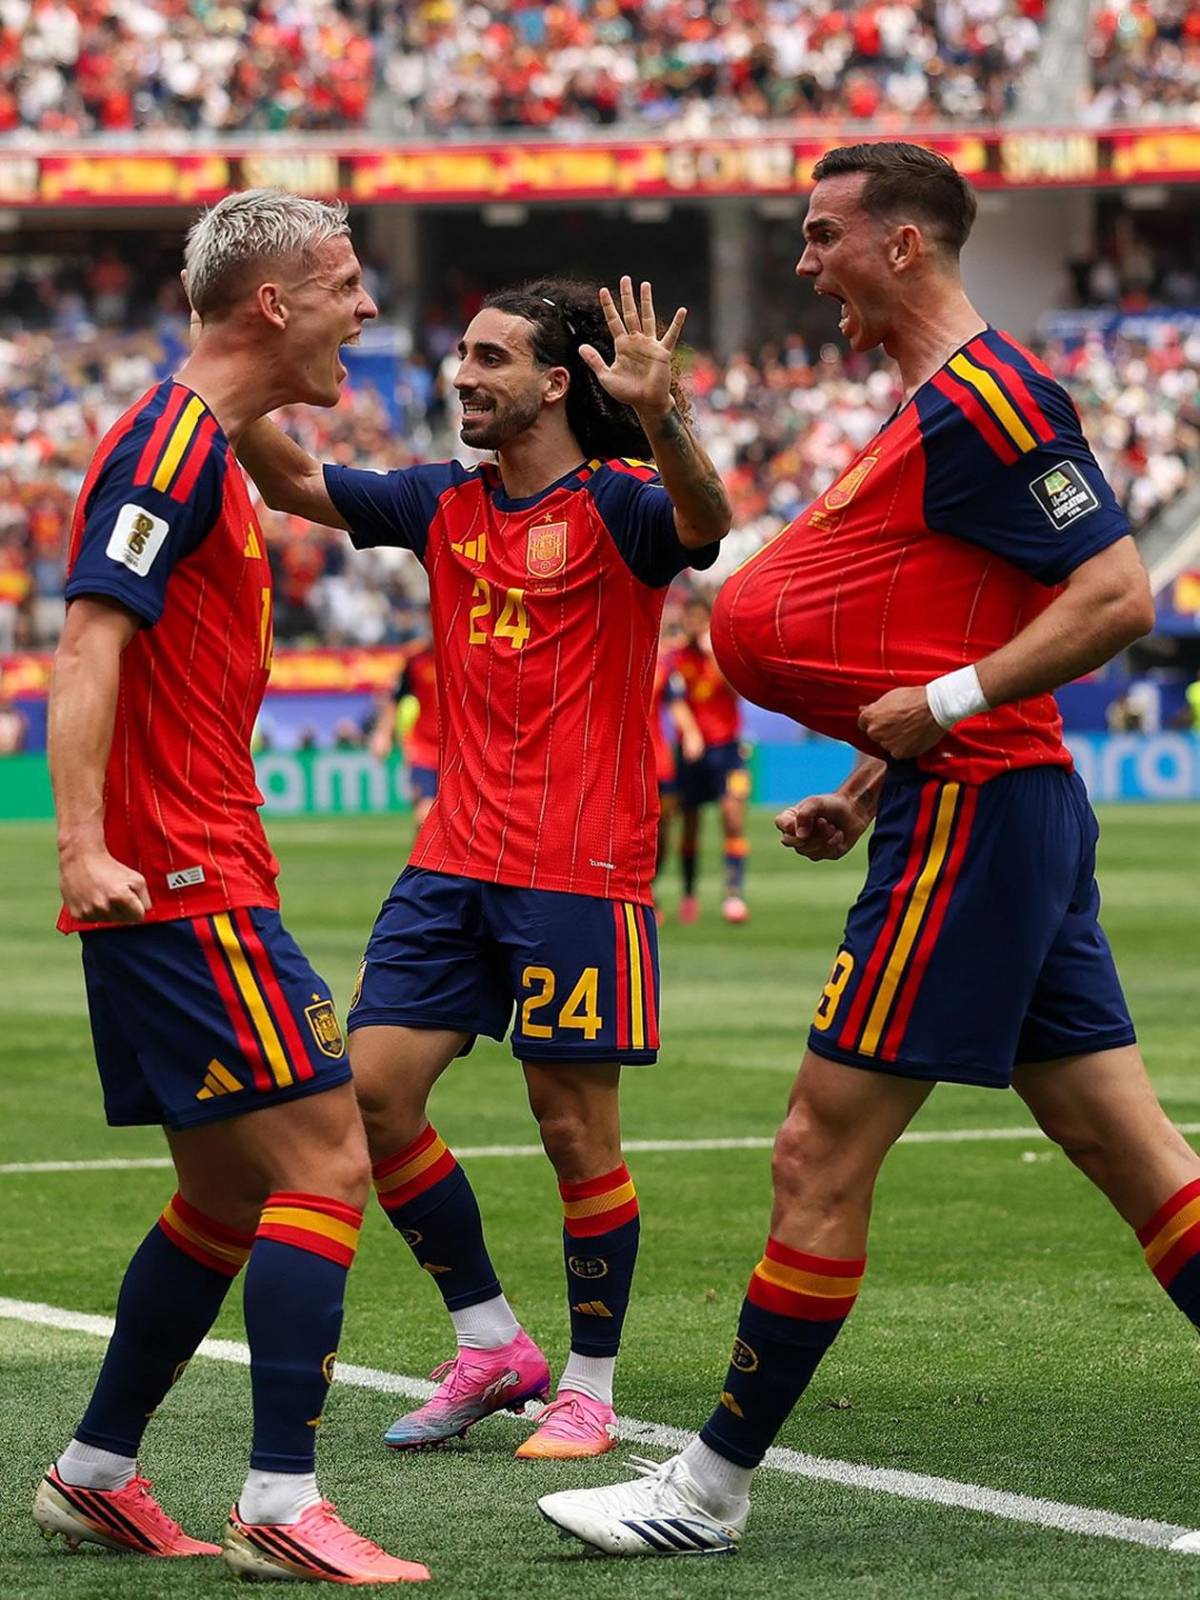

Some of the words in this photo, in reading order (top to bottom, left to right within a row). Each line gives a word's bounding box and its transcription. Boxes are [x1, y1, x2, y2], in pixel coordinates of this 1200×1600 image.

[1052, 490, 1089, 519] EDUCATION
[469, 578, 531, 650] 24
[522, 965, 603, 1040] 24
[814, 950, 854, 1032] 8
